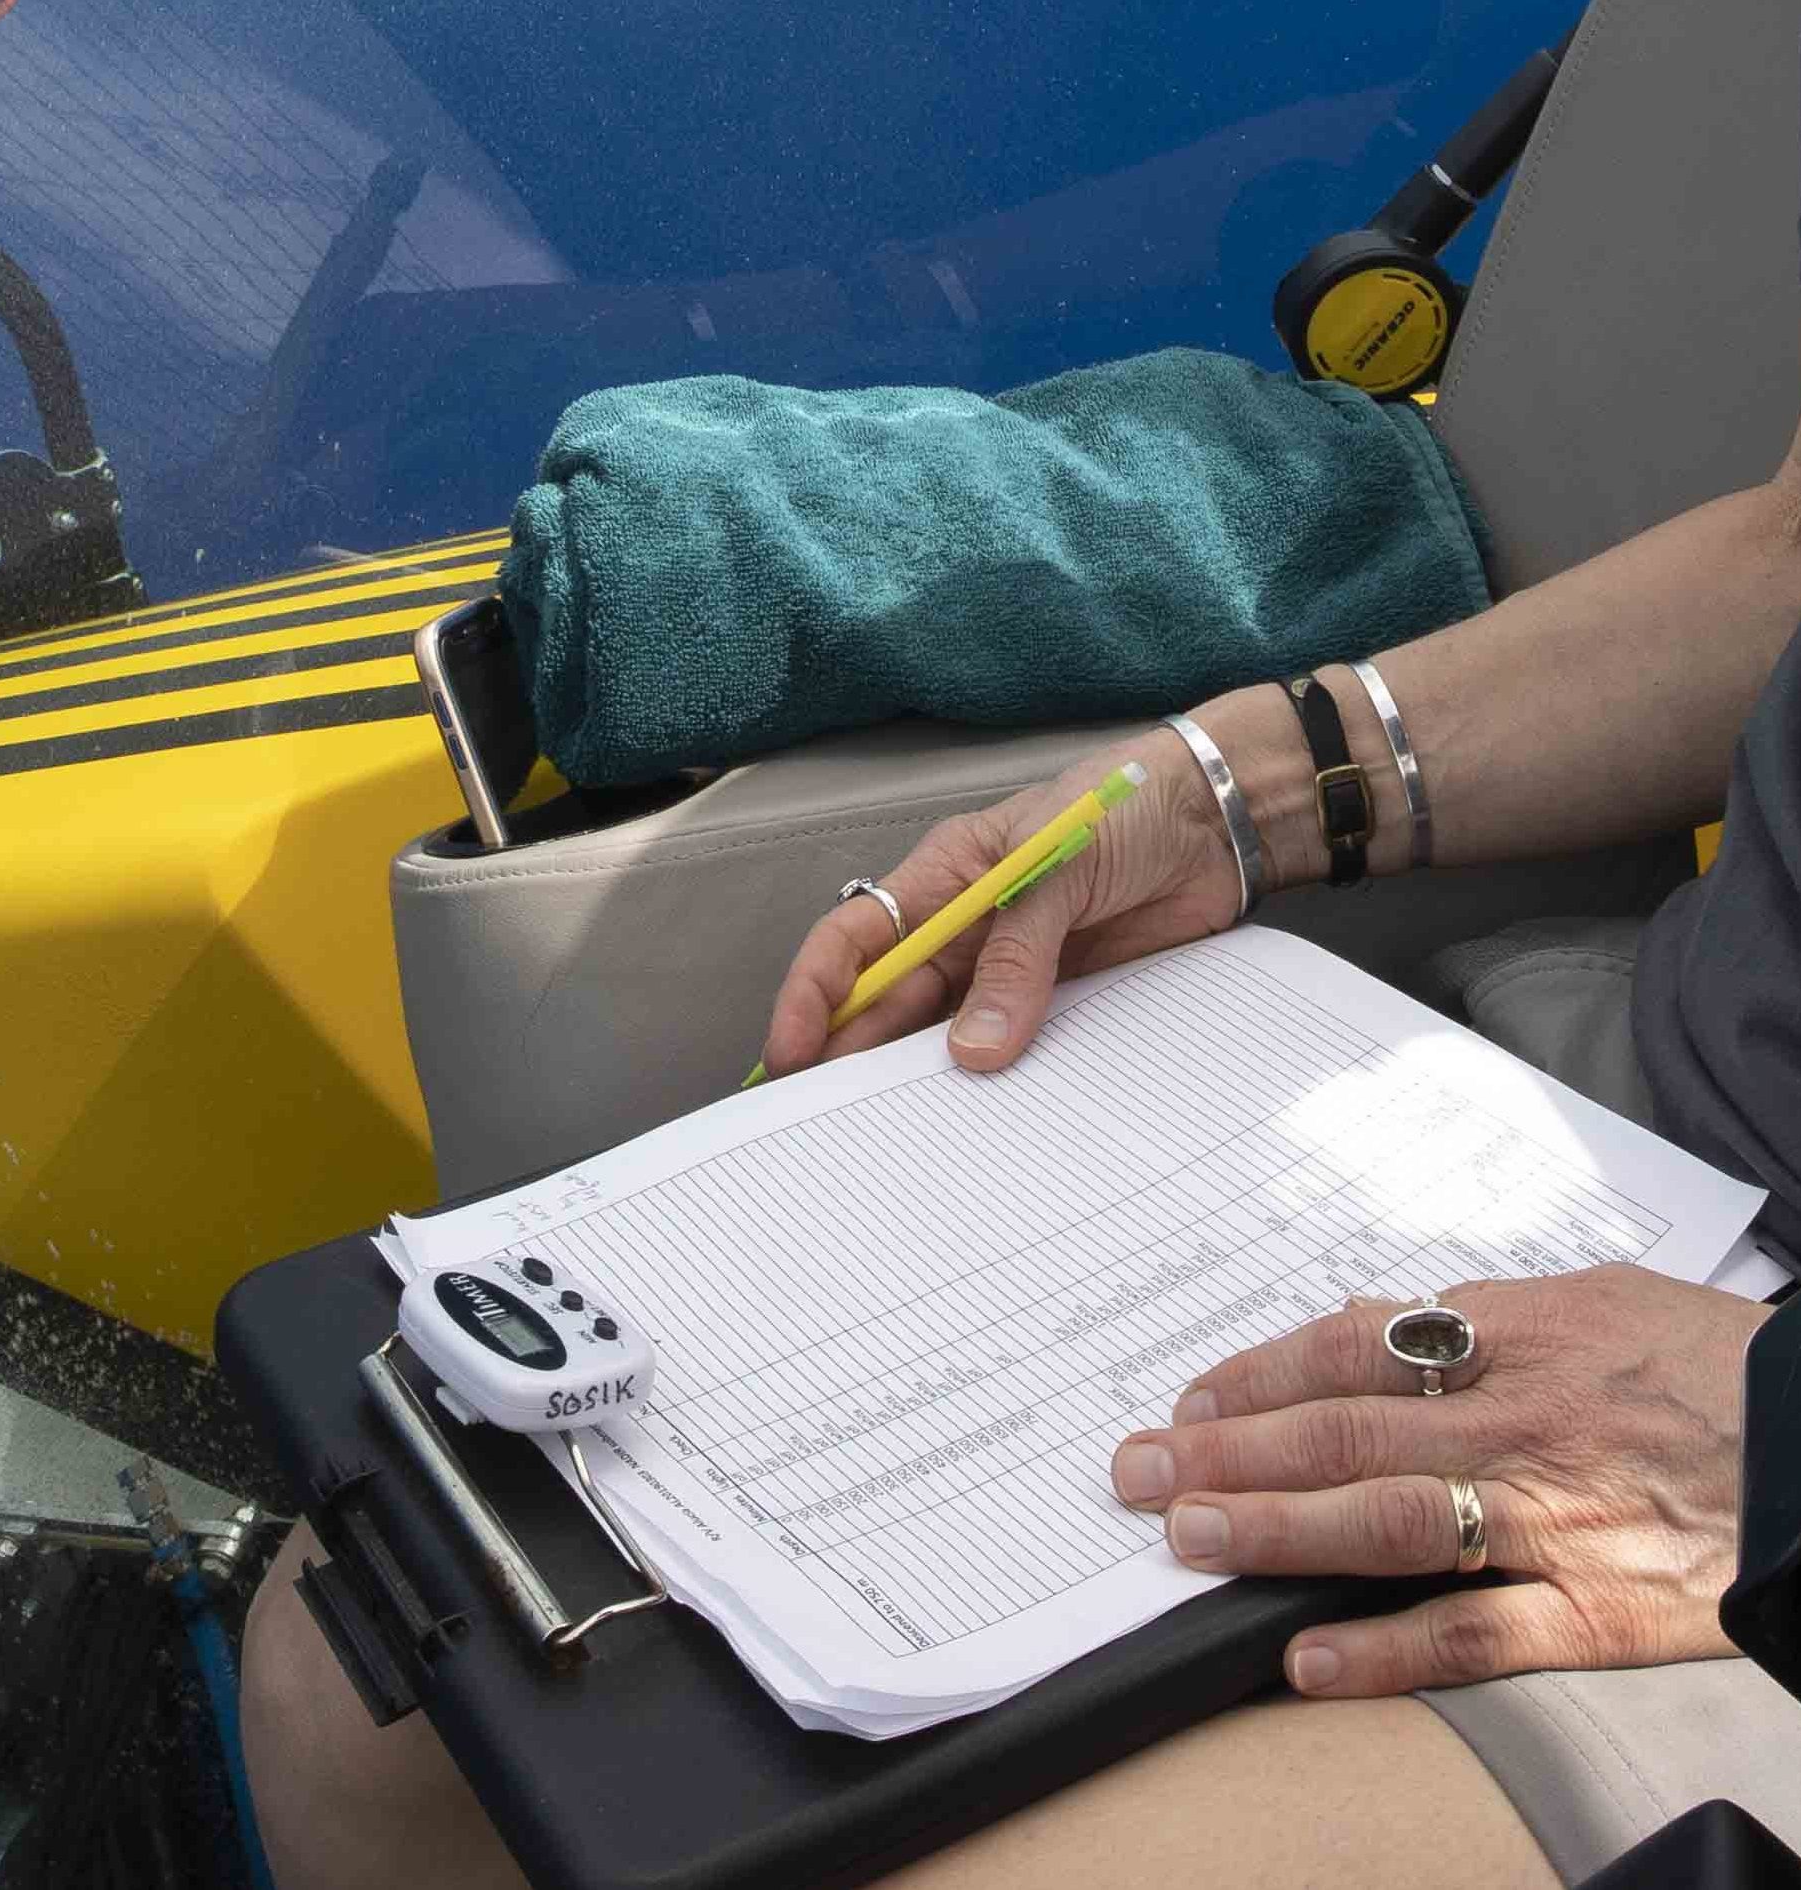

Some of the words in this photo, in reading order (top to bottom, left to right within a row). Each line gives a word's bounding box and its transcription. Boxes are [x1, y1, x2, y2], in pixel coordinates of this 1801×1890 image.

[1353, 300, 1416, 372] OCEANIC
[1349, 1258, 1376, 1277] MARK
[1324, 1273, 1351, 1294] MARK
[447, 1274, 510, 1326] TIMER
[1291, 1293, 1318, 1313] MARK
[1108, 1388, 1137, 1409] MARK
[669, 1434, 693, 1455] Check
[706, 1468, 730, 1489] Lights
[734, 1495, 767, 1522] Minutes
[779, 1535, 806, 1556] Depth
[857, 1578, 869, 1587] m
[864, 1587, 885, 1604] 750
[883, 1604, 895, 1614] to
[890, 1614, 931, 1648] Descend
